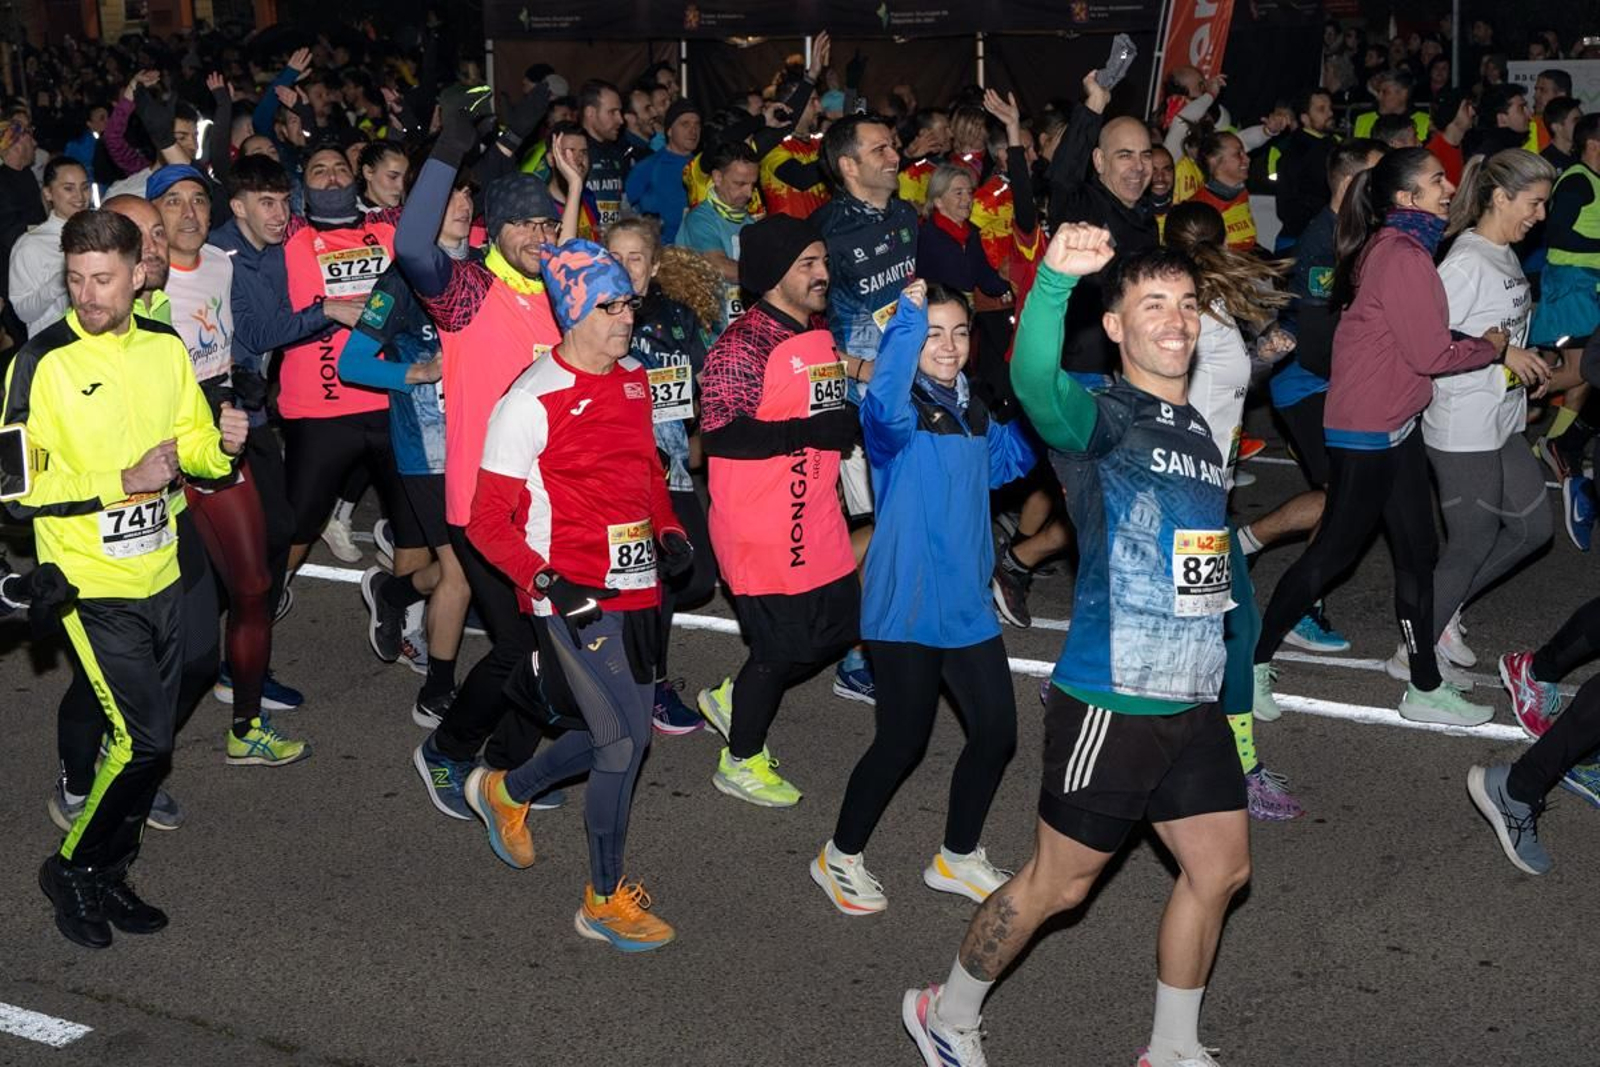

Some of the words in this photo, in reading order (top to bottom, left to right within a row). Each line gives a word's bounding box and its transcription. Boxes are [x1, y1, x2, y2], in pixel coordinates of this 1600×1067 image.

[327, 256, 384, 278] 6727
[631, 336, 651, 355] AN
[1149, 447, 1197, 479] SAN
[107, 497, 167, 534] 7472
